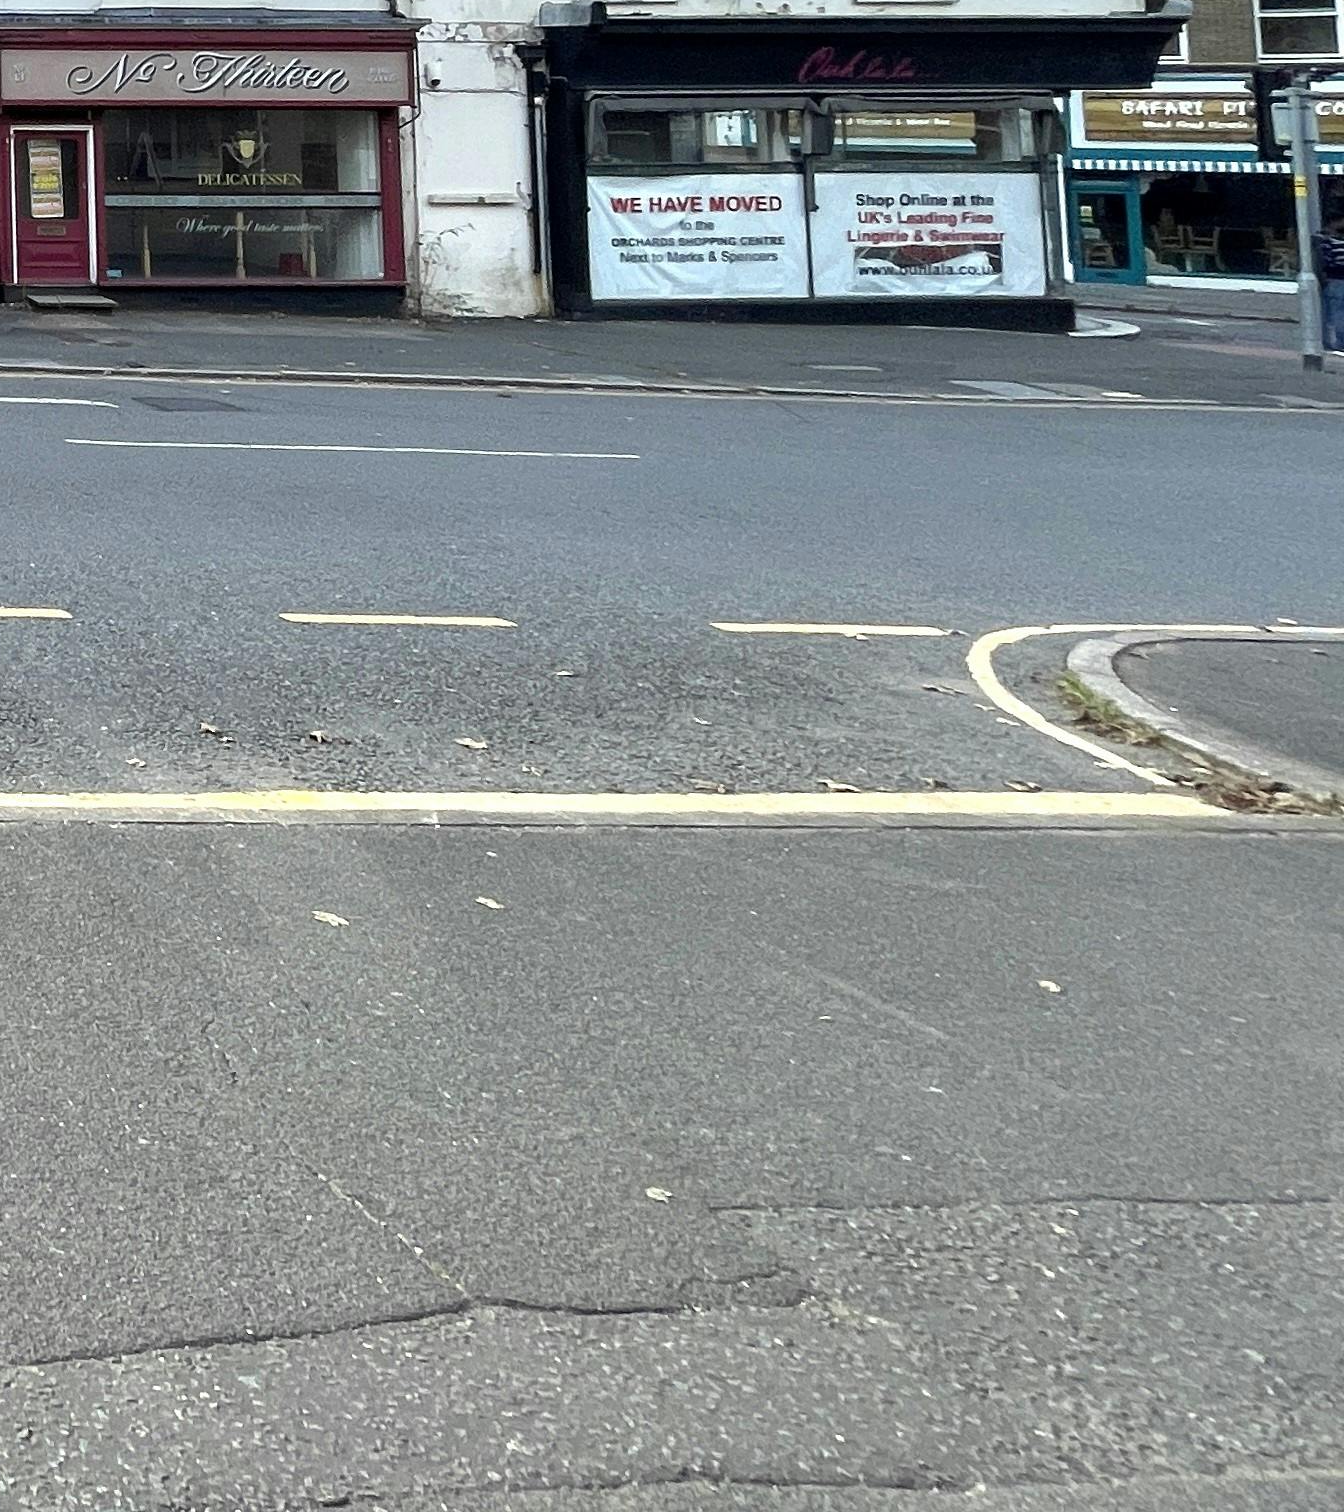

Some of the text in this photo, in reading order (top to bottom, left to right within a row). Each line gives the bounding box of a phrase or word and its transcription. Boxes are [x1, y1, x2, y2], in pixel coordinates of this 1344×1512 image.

[176, 51, 349, 94] Thirteen
[1121, 100, 1204, 115] SAFARI
[198, 173, 302, 185] DELICATESSEN
[610, 196, 783, 213] WE HAVE MOVED
[856, 193, 994, 208] Shop Online at the
[176, 217, 222, 233] Where
[679, 220, 715, 230] to the
[857, 211, 994, 227] UK's Leading Fine
[612, 236, 785, 247] ORCHARDS SHOPPING CENTRE
[847, 229, 1005, 244] Lingerie & Swimwear
[620, 251, 778, 264] Next to Marks & Spencers
